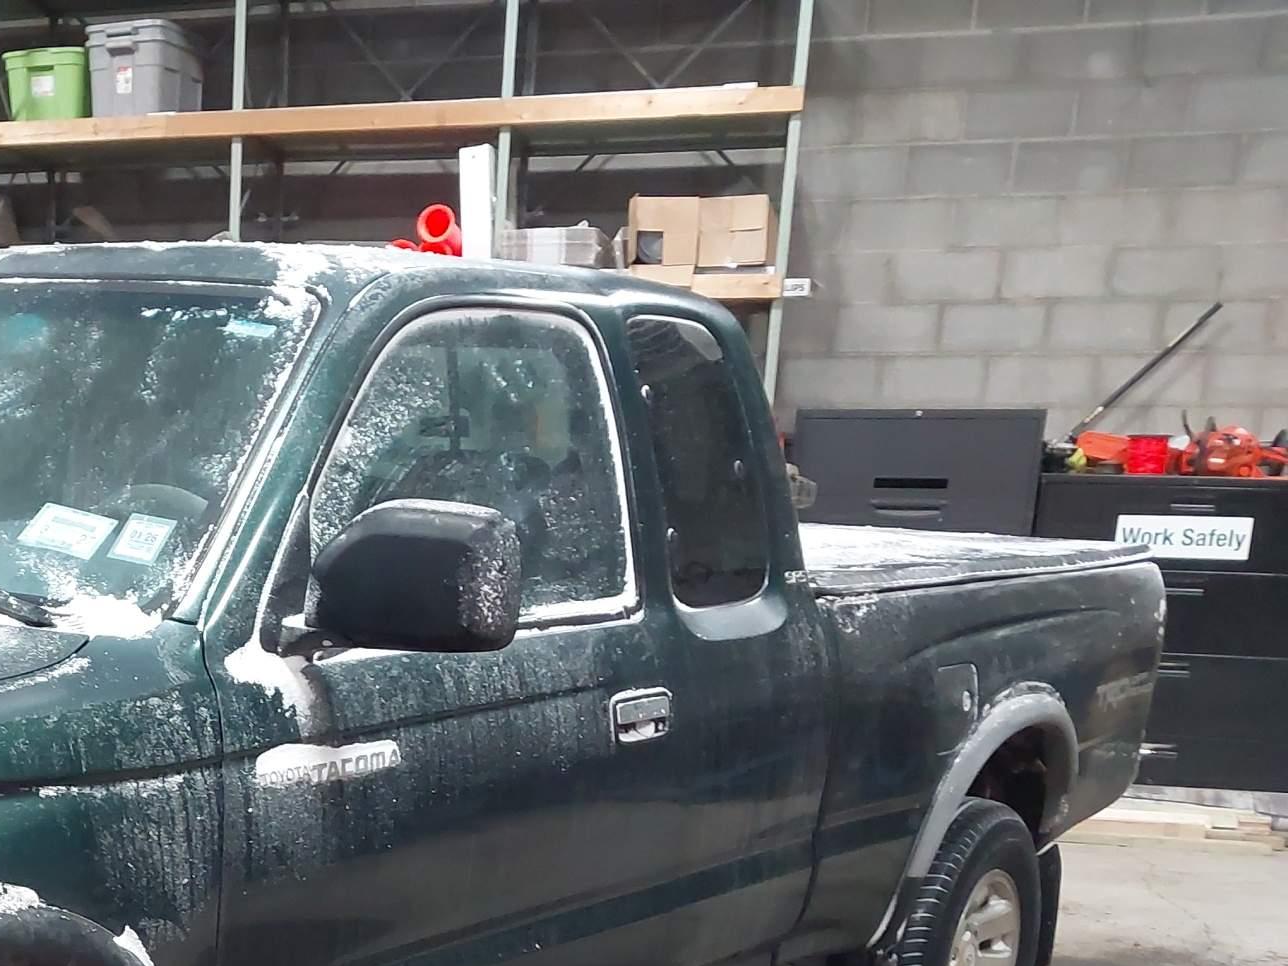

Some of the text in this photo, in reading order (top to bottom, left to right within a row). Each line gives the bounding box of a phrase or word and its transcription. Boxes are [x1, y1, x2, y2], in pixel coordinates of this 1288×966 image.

[1122, 527, 1246, 551] Work Safely
[259, 748, 400, 787] TOYOTA TACOMA
